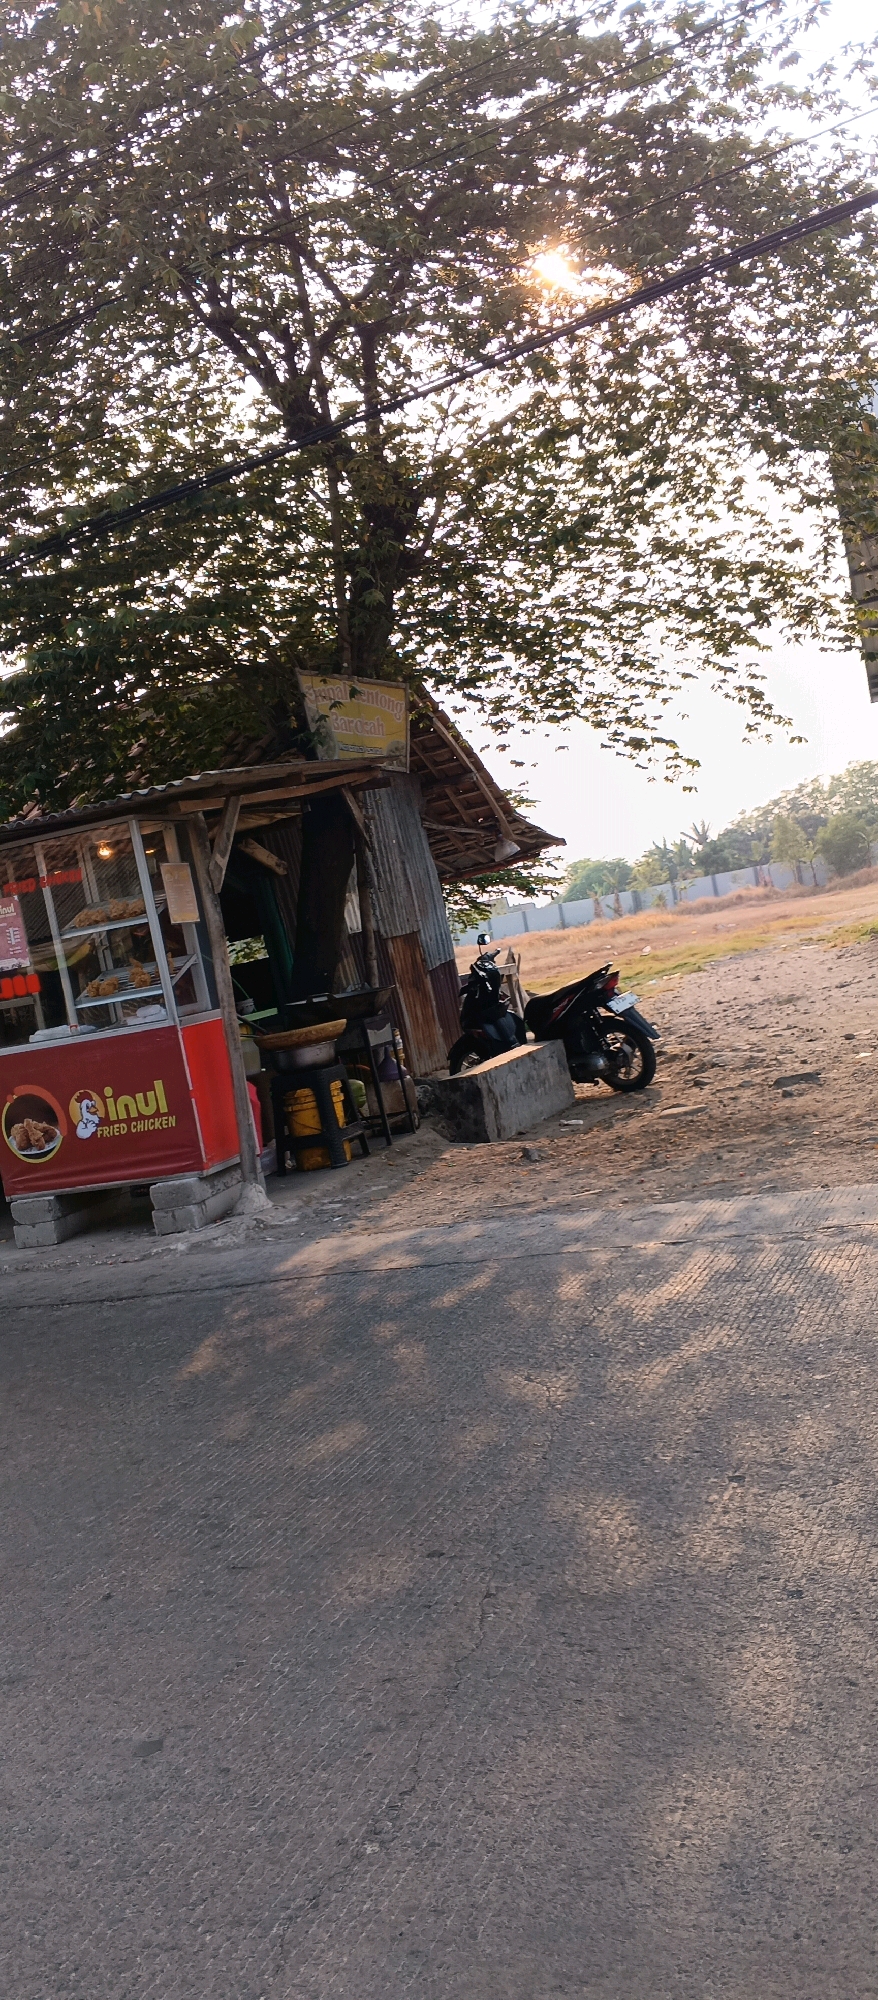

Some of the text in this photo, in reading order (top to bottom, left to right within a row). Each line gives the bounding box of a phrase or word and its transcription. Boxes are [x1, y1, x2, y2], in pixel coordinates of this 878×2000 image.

[350, 681, 404, 720] entong
[97, 1116, 176, 1138] FRIED CHICKEN
